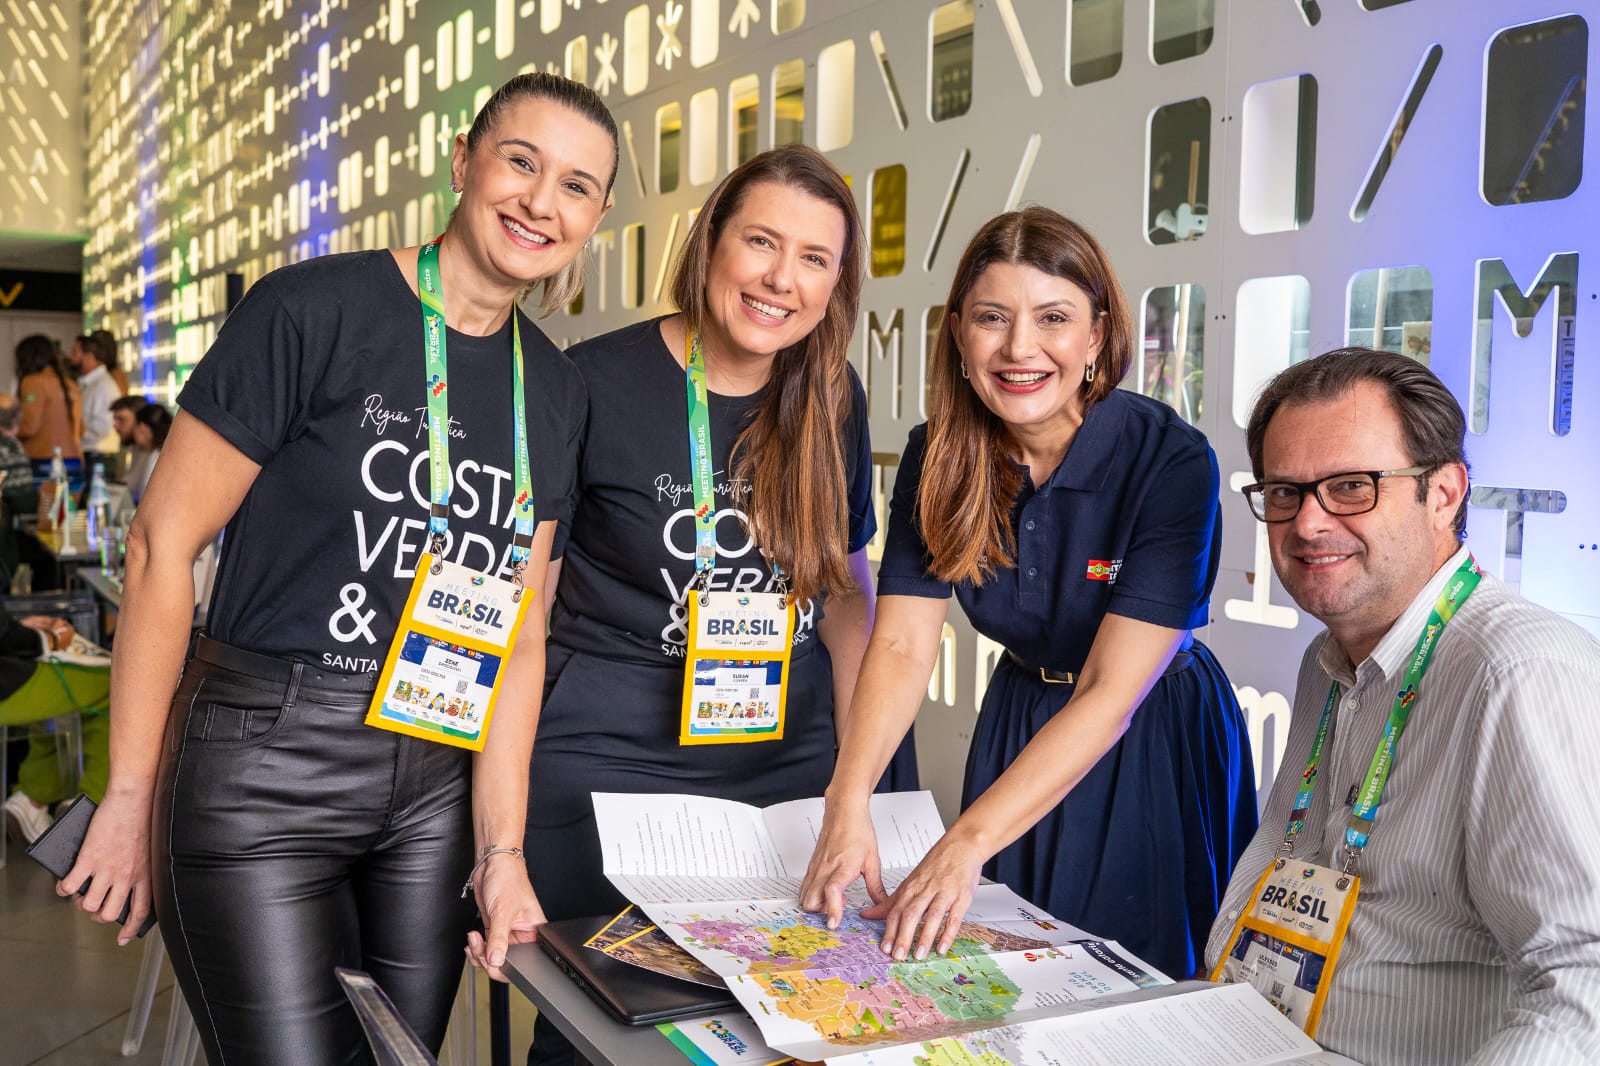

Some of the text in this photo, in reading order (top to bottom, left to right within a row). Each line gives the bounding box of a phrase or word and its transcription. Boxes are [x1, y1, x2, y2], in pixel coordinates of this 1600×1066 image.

[361, 394, 412, 436] Região
[698, 424, 706, 458] BRASIL
[700, 463, 711, 499] MEETING
[427, 589, 503, 629] BRASIL
[446, 583, 499, 605] MEETING
[328, 583, 377, 645] &
[706, 619, 779, 636] BRASIL
[719, 609, 768, 618] MEETING
[322, 652, 379, 673] SANTA
[1373, 726, 1398, 777] MEETING
[1359, 776, 1381, 816] BRASIL
[1260, 885, 1330, 923] BRASIL
[1278, 877, 1324, 896] MEETING
